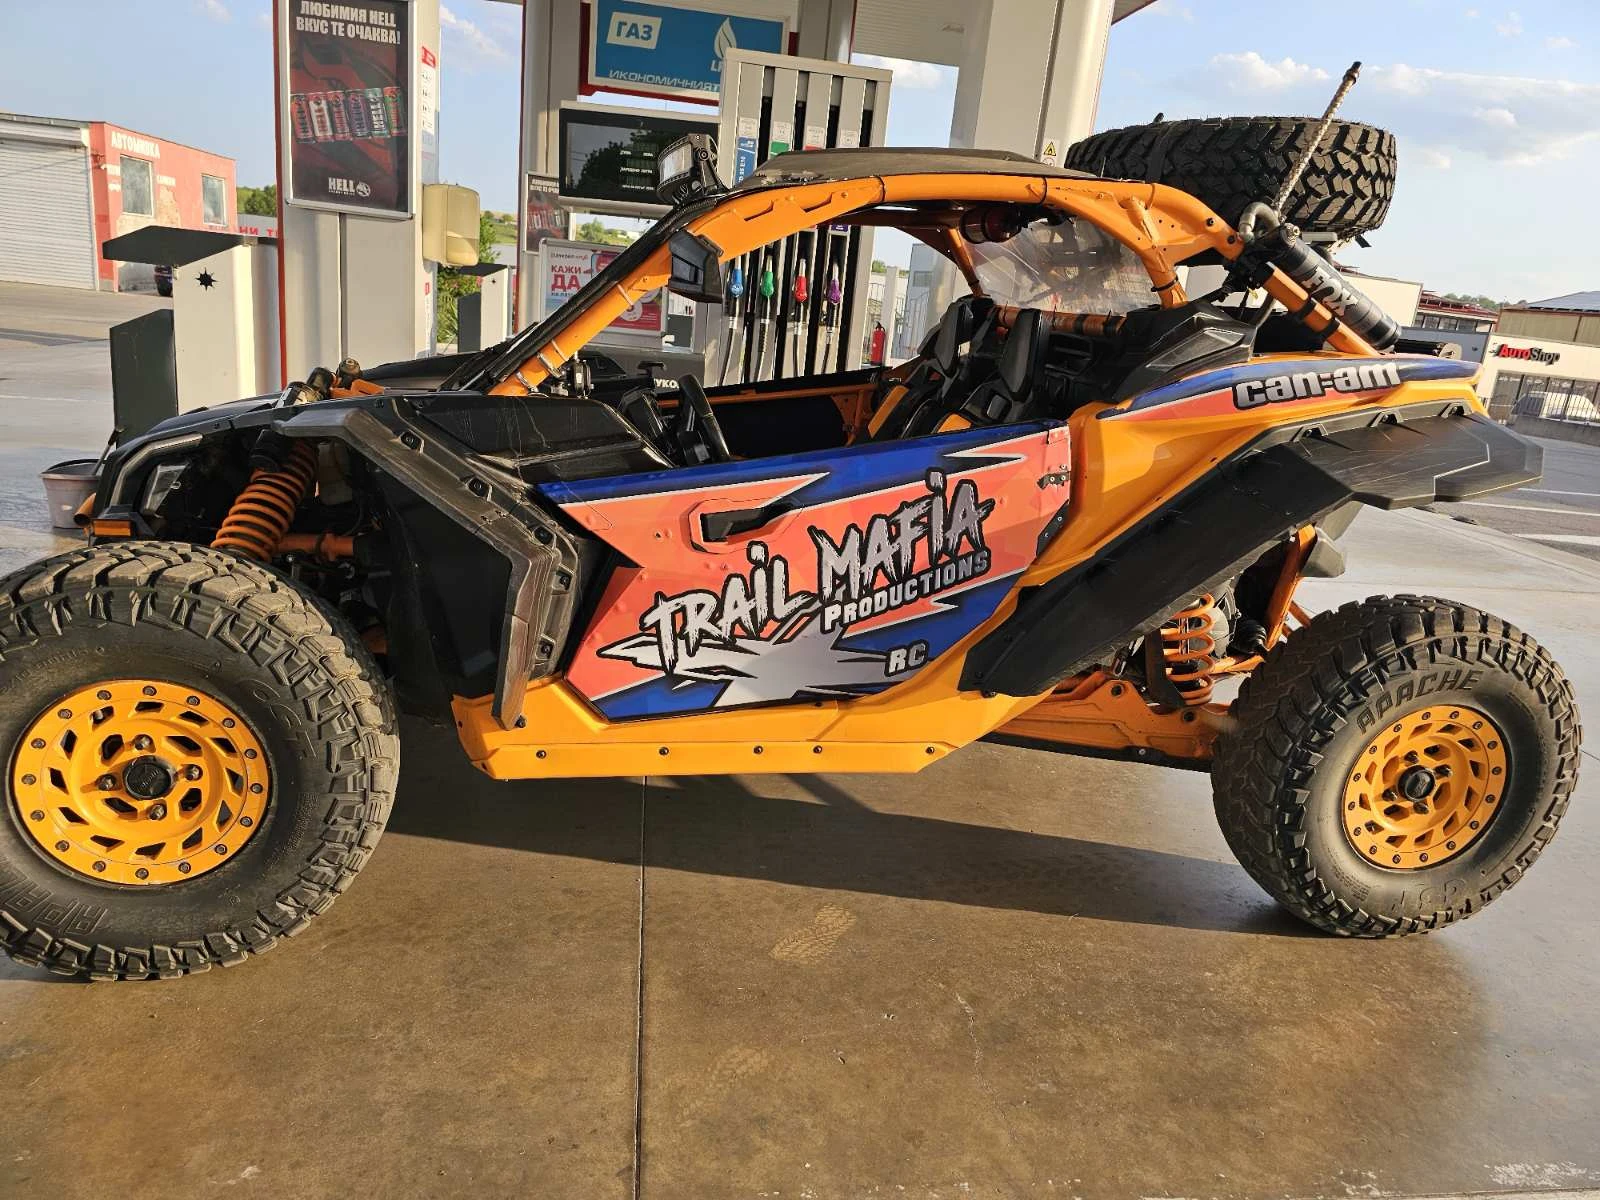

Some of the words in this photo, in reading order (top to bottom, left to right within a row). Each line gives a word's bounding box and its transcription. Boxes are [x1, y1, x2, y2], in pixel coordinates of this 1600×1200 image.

[300, 1, 367, 22] ЛЮБИМИЯ
[369, 10, 396, 27] HELL
[296, 17, 329, 34] ВКУС
[331, 21, 345, 37] ТЕ
[347, 23, 401, 45] ОЧАКВА!
[616, 21, 654, 41] ГАЗ
[609, 69, 721, 92] ИКОНОМИЧНИЯТ
[370, 102, 386, 129] HELL
[328, 176, 356, 192] HELL
[551, 265, 582, 274] КАЖИ
[551, 274, 581, 292] ДА
[1301, 266, 1359, 317] FOX
[1233, 362, 1401, 409] can-am
[638, 540, 813, 675] TRAIL
[807, 467, 996, 602] MAFIA
[820, 549, 990, 633] PRODUCTIONS
[884, 639, 929, 677] RC
[1356, 669, 1484, 735] APACHE
